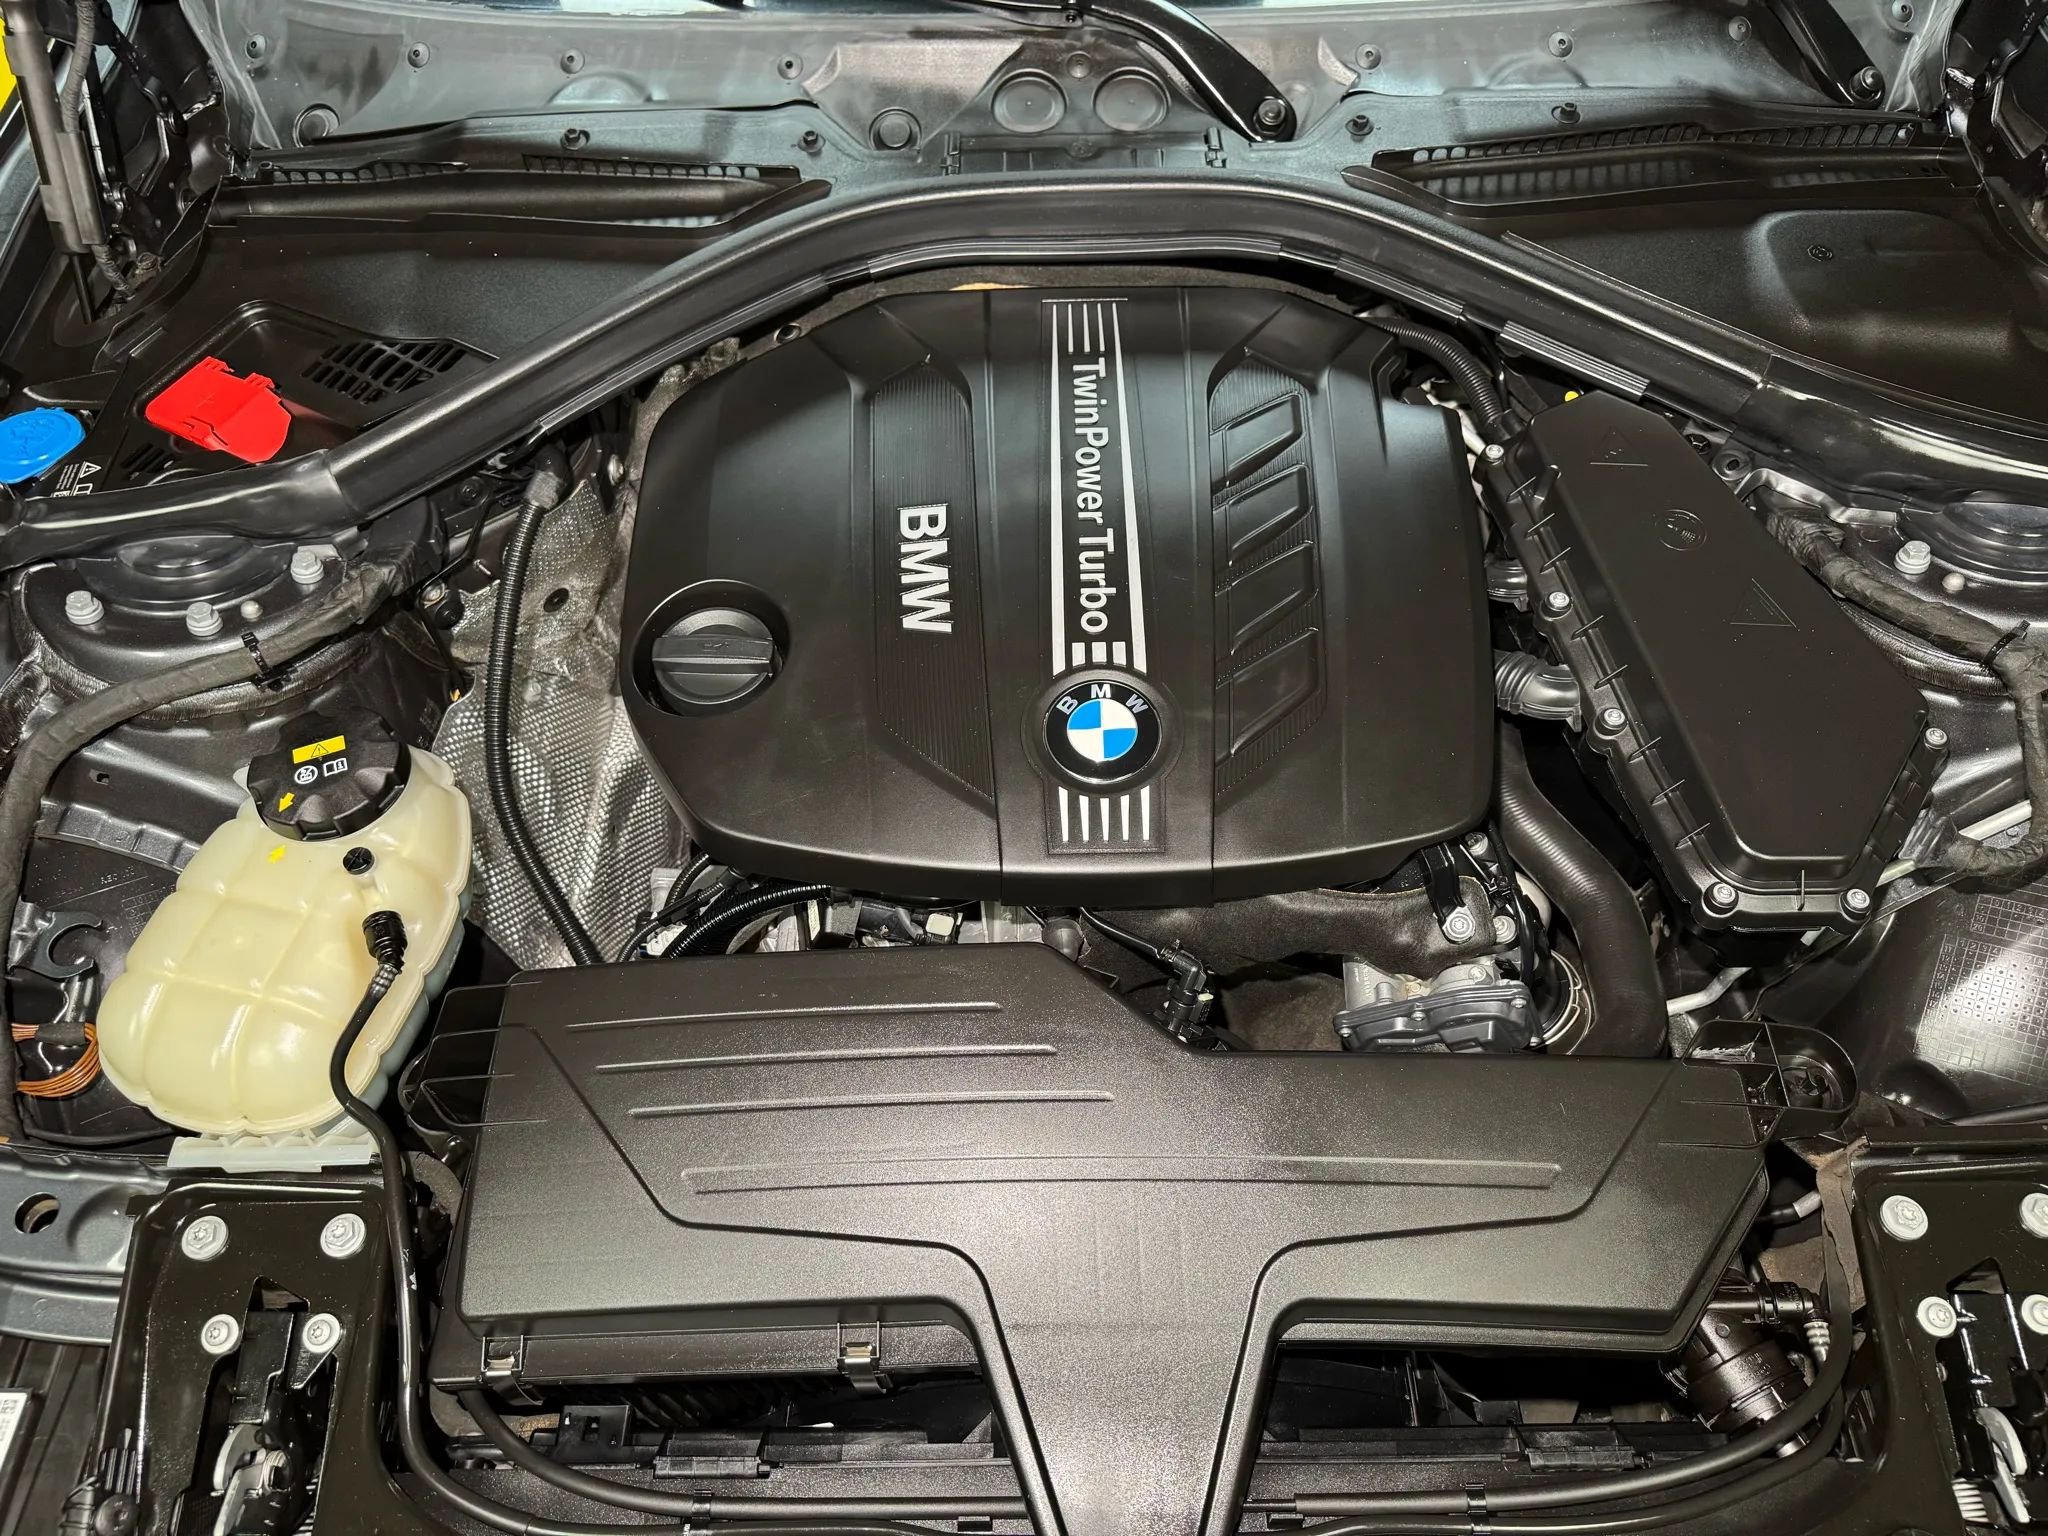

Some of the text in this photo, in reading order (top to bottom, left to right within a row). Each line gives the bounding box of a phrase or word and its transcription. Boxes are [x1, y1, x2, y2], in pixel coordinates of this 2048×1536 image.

[1072, 356, 1117, 634] TwinPower Turbo
[898, 503, 954, 634] BMW
[1055, 683, 1149, 716] BMW
